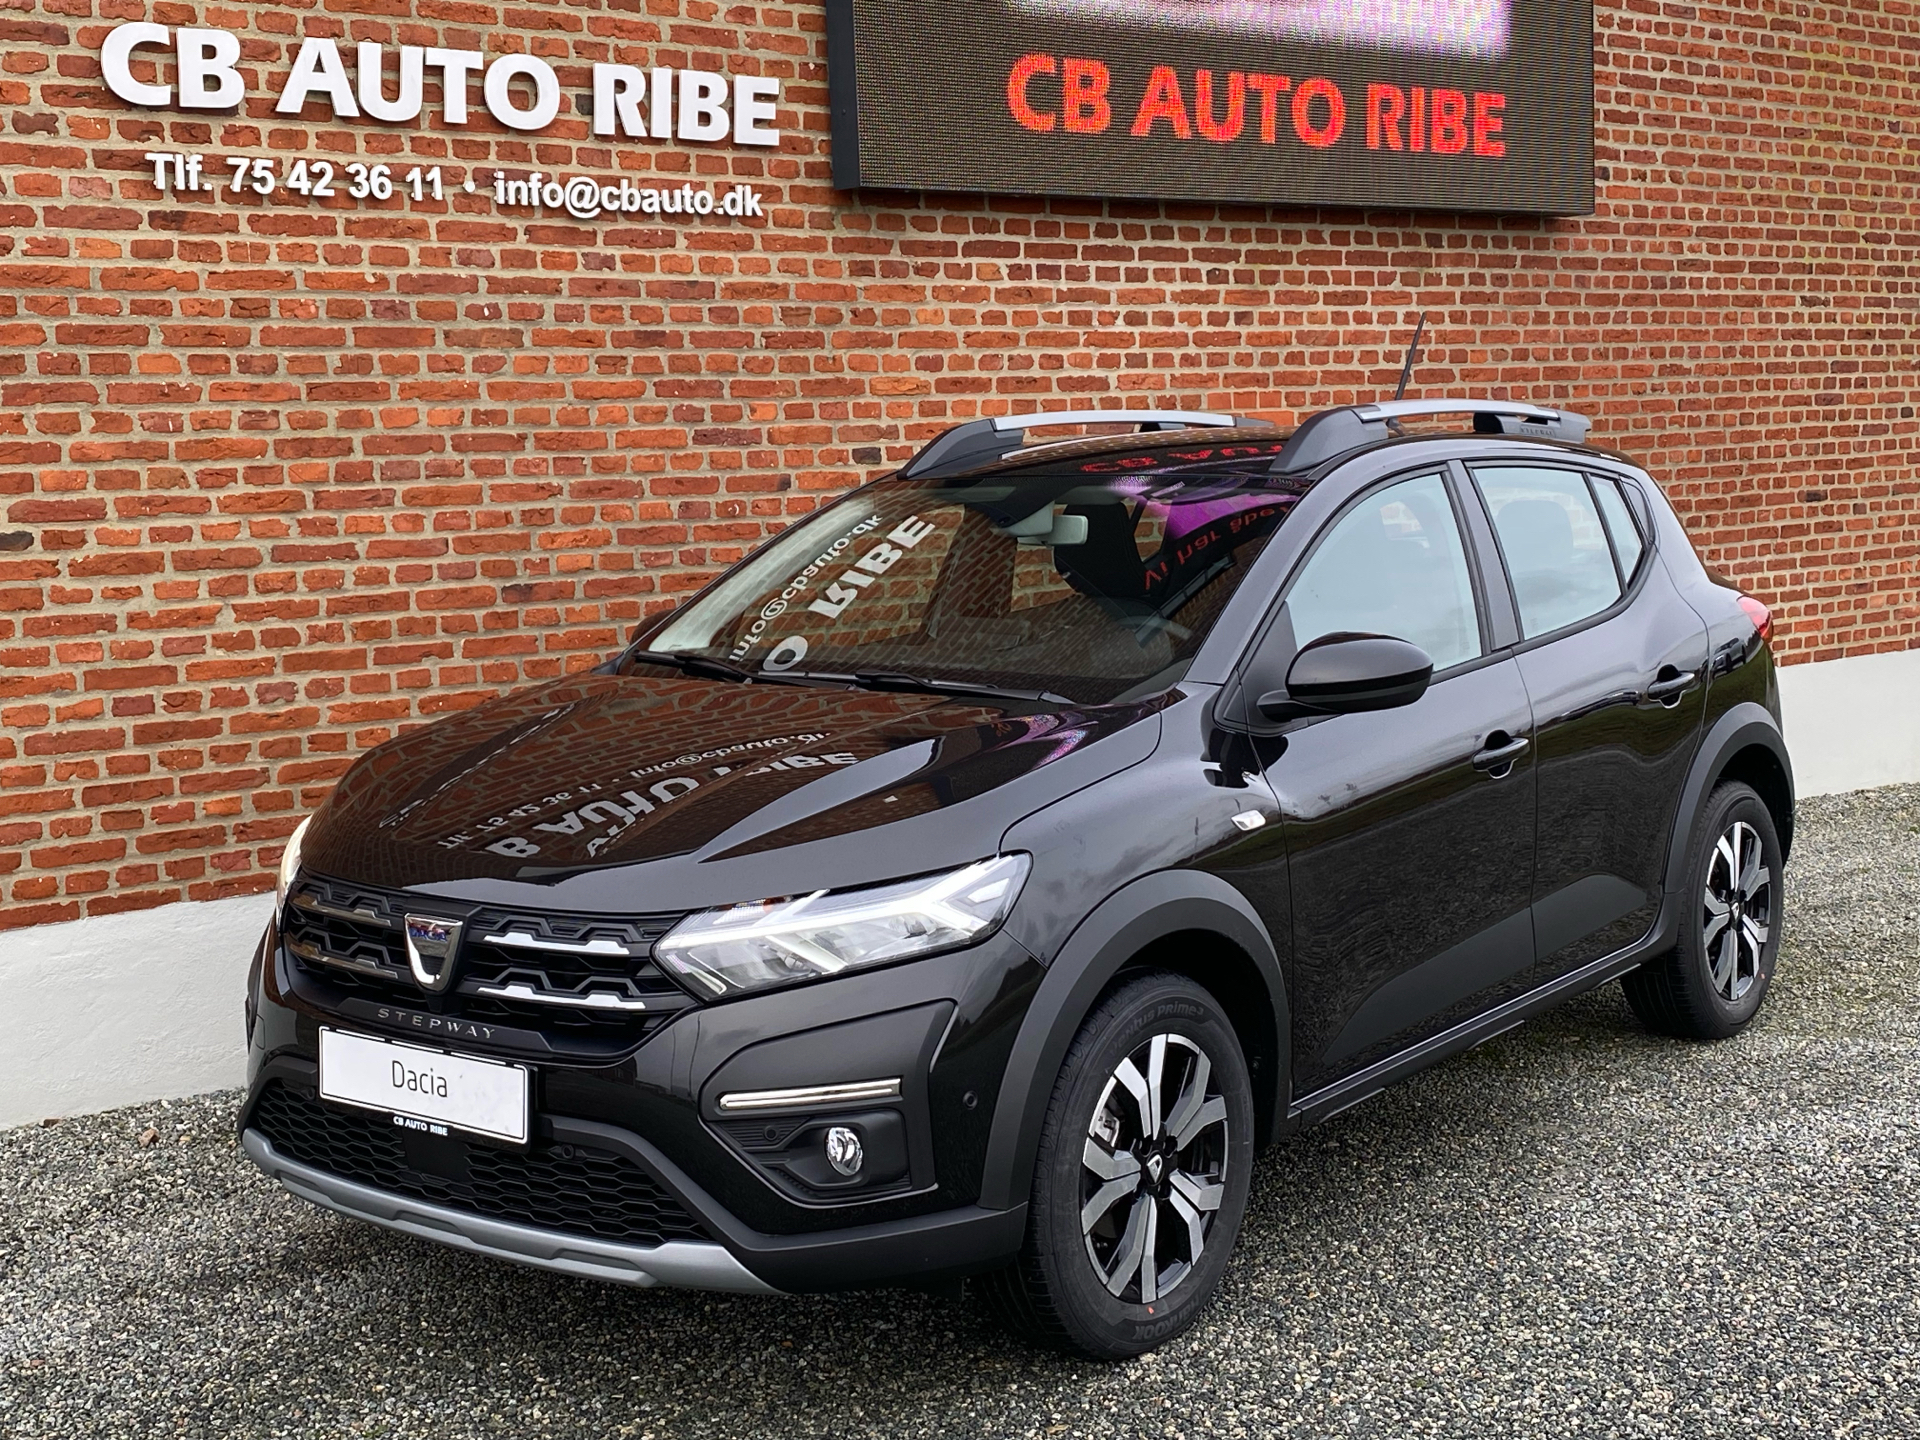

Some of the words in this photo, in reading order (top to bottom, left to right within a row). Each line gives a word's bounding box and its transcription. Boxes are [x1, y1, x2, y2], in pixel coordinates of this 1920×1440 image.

[100, 21, 246, 111] CB
[275, 36, 562, 131] AUTO
[593, 61, 781, 147] RIBE
[1006, 52, 1112, 136] CB
[1130, 64, 1345, 149] AUTO
[1365, 81, 1507, 156] RIBE
[144, 152, 212, 194] Tlf.
[226, 154, 277, 197] 75
[286, 159, 336, 200] 42
[344, 162, 394, 202] 36
[405, 165, 444, 202] 11
[493, 171, 765, 219] info@cbauto.dk
[376, 1007, 496, 1040] STEPWAY
[391, 1059, 448, 1098] Dacia
[393, 1115, 404, 1126] CB
[405, 1118, 428, 1132] AUTO
[429, 1124, 448, 1137] RIBE
